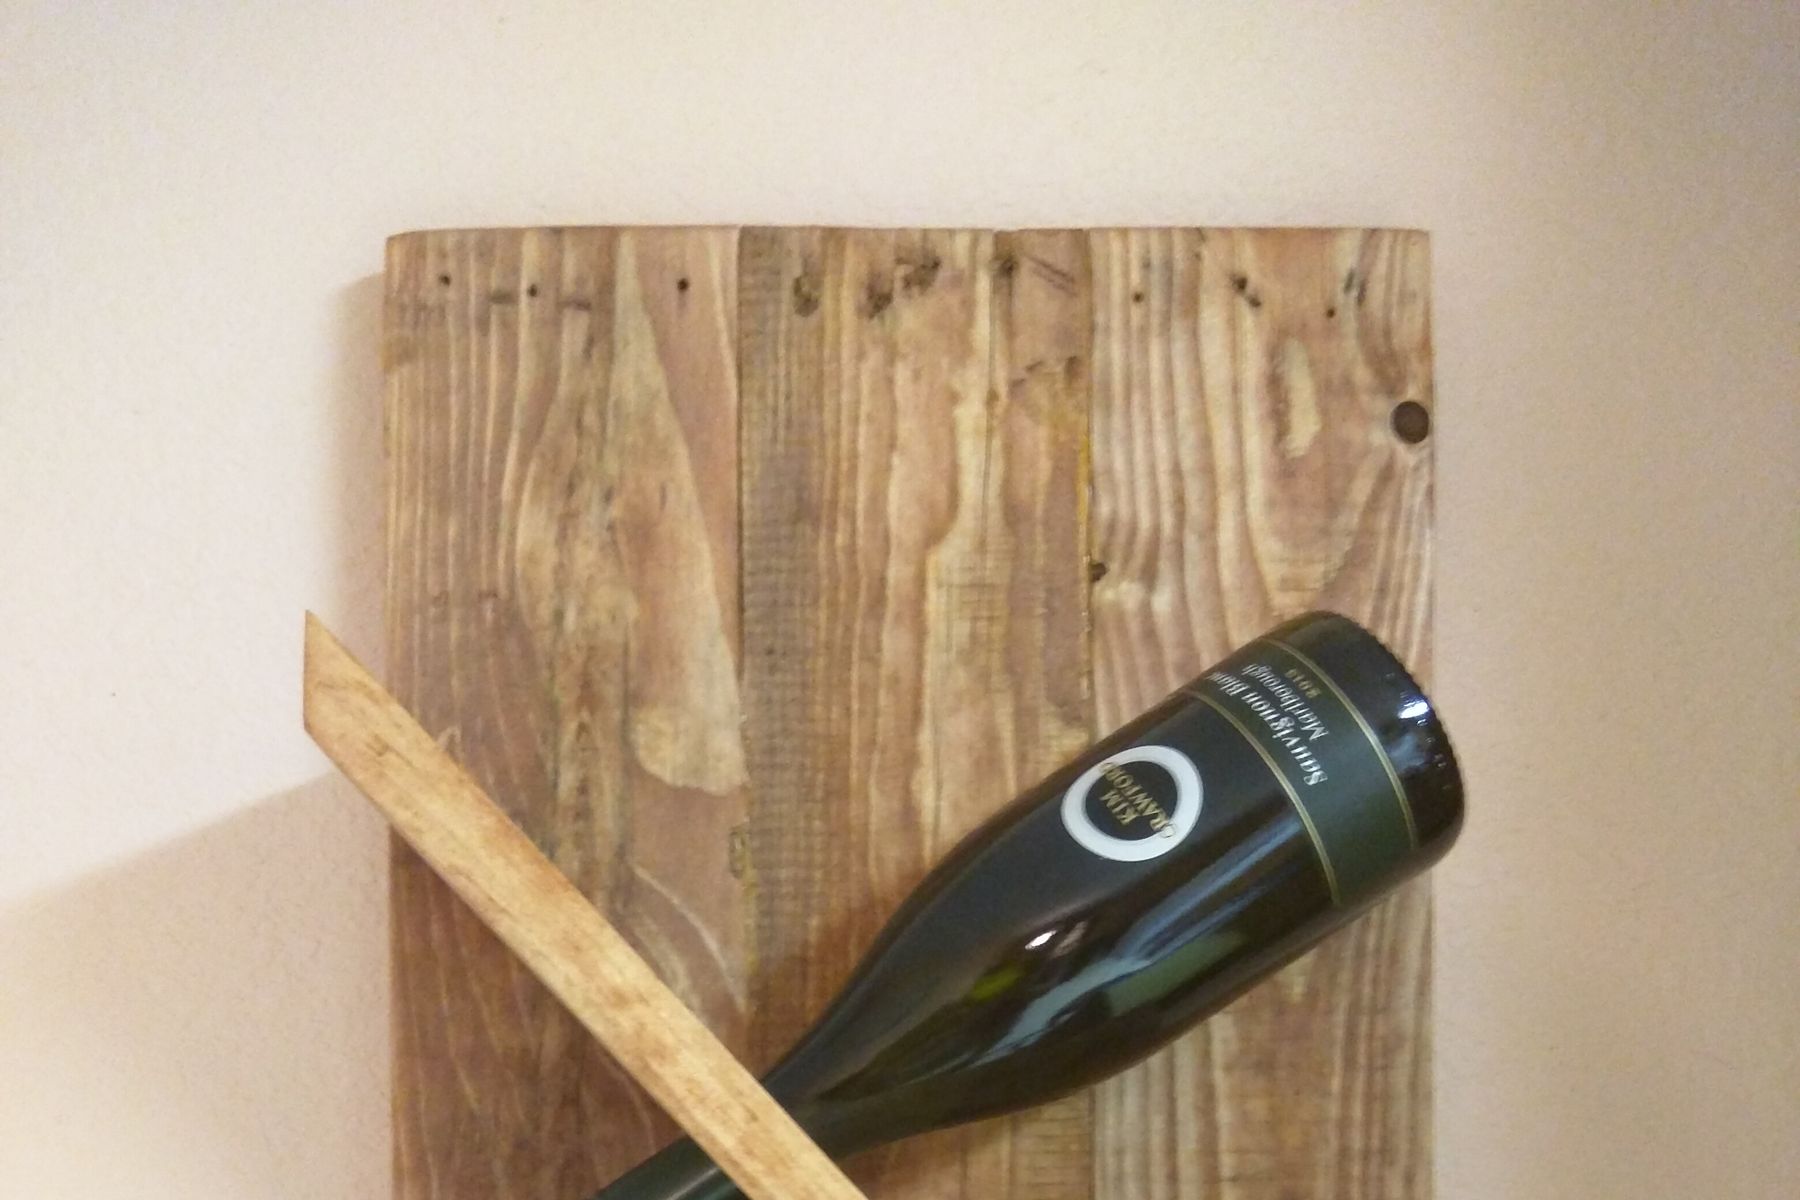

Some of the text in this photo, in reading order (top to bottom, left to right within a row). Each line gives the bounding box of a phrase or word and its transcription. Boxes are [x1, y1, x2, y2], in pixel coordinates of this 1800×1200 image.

[1240, 687, 1328, 786] Sauvignon
[1241, 663, 1329, 742] Marlborough
[1100, 761, 1177, 839] CRAWFORD
[1100, 790, 1139, 826] KIM
